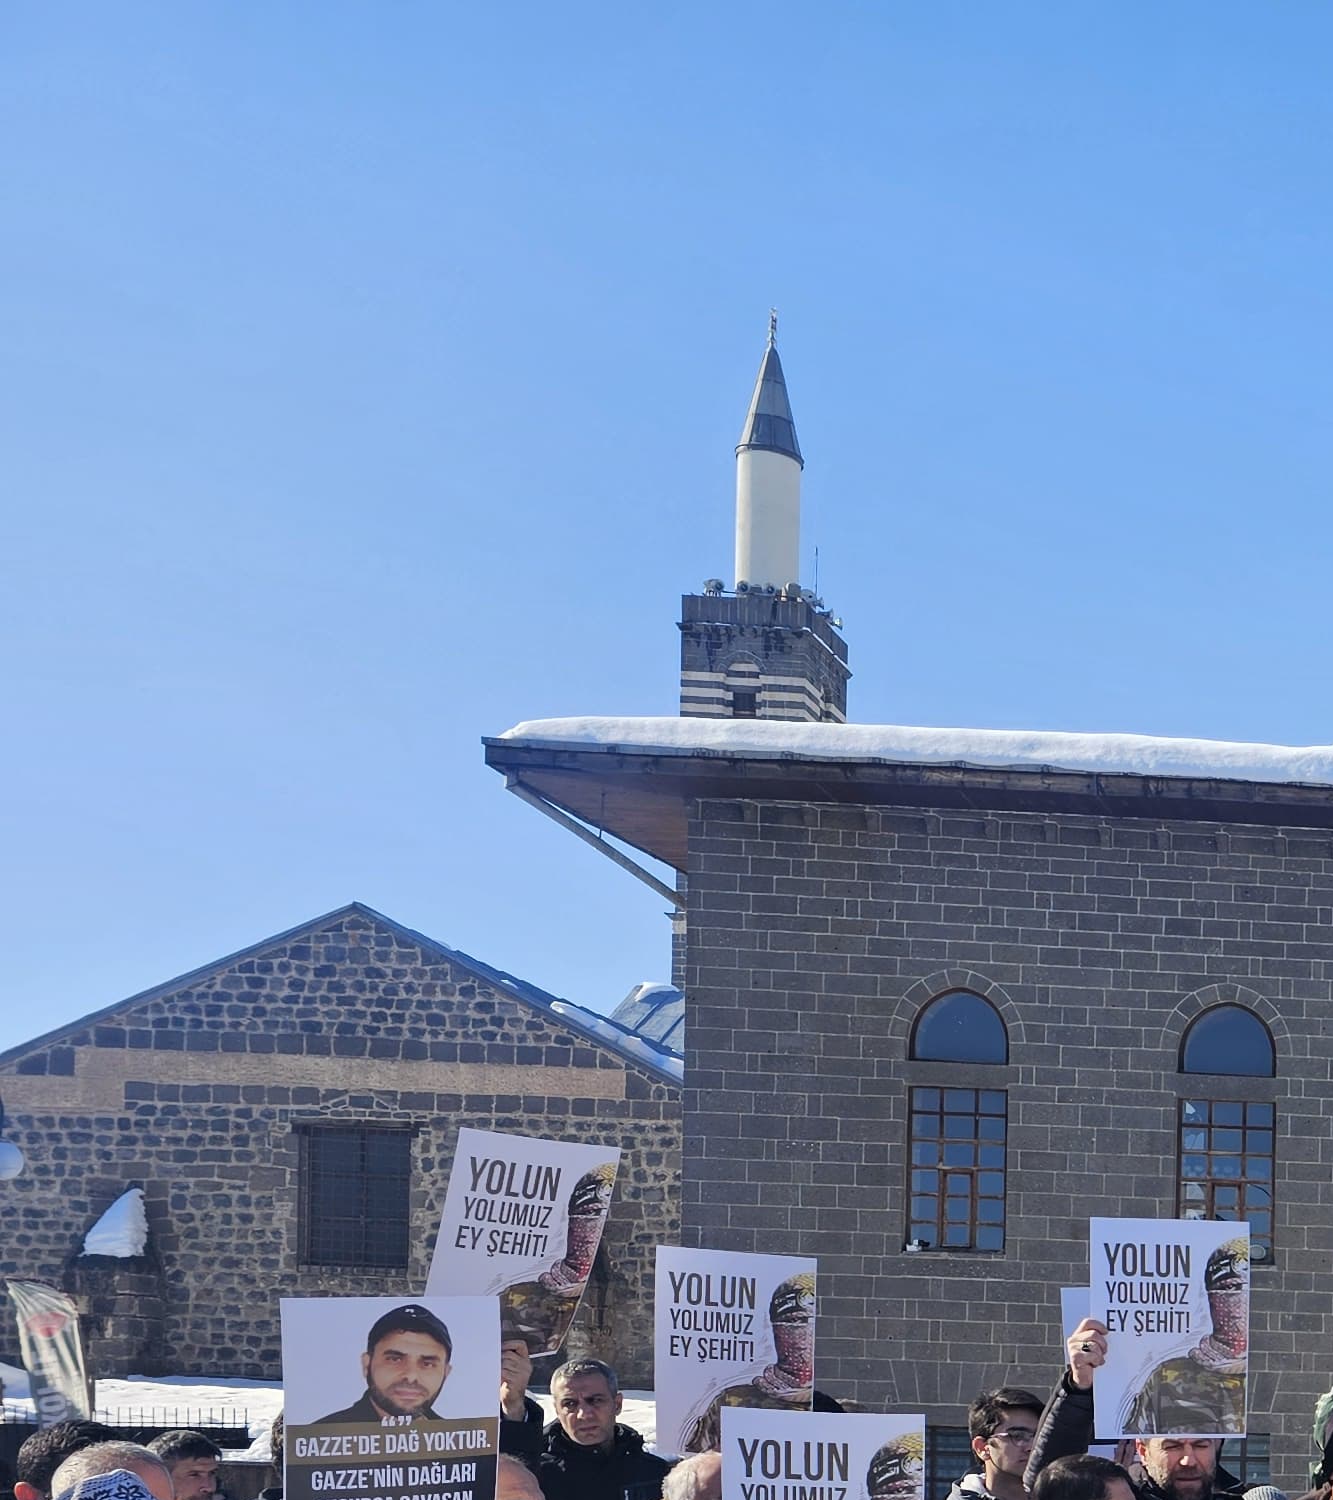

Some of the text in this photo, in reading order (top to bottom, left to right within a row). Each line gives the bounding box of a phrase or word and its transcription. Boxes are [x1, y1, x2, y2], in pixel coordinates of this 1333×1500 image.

[470, 1156, 561, 1201] YOLUN
[464, 1196, 553, 1229] YOLUMUZ
[455, 1225, 548, 1258] EY ŞEHİT!
[1104, 1243, 1190, 1278] YOLUN
[668, 1271, 756, 1310] YOLUN
[1105, 1281, 1189, 1305] YOLUMUZ
[670, 1308, 754, 1335] YOLUMUZ
[1106, 1307, 1190, 1337] EY ŞEHİT!
[670, 1335, 754, 1363] EY ŞEHİT!
[295, 1429, 491, 1457] GAZZE'DE DAĞ YOKTUR.
[738, 1438, 849, 1481] YOLUN
[311, 1462, 477, 1491] GAZZE'NİN DAĞLARI
